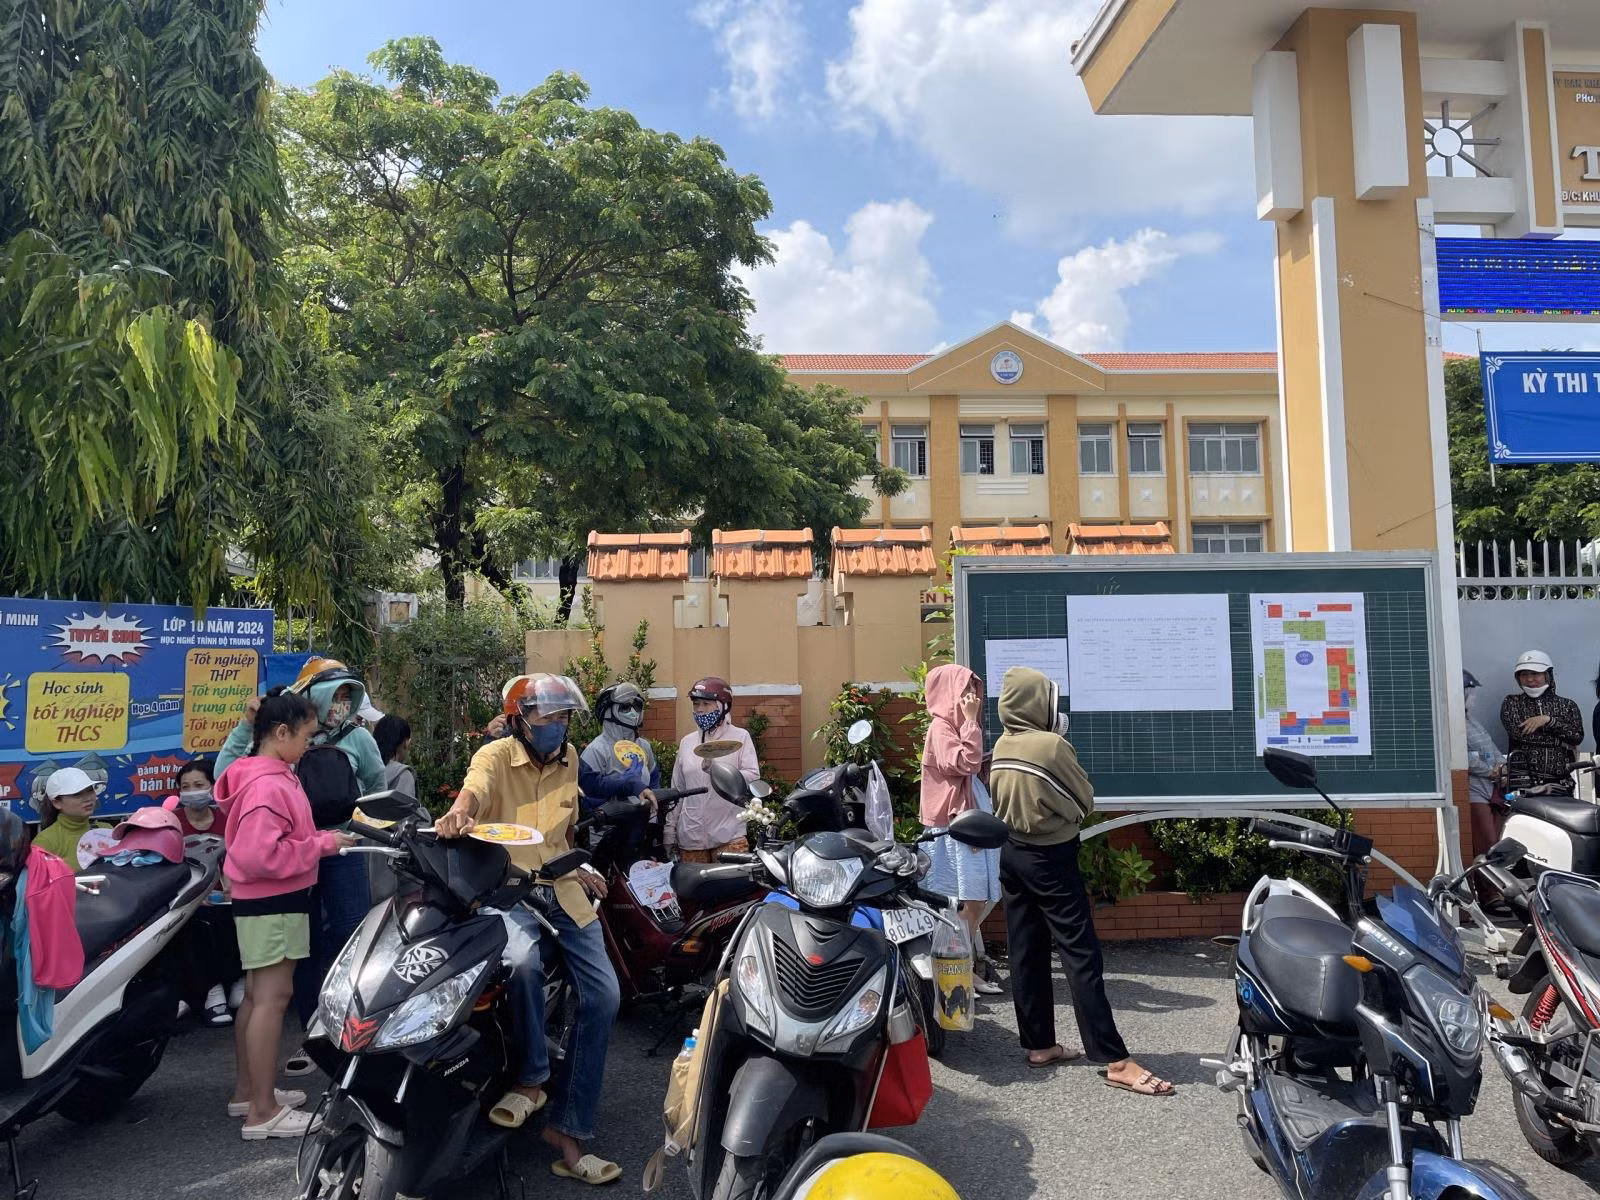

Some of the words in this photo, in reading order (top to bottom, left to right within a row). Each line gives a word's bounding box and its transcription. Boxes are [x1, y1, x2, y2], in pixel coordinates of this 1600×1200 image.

[1522, 367, 1548, 393] KỲ
[1553, 372, 1588, 393] THI
[6, 613, 39, 626] MINH
[163, 617, 186, 632] LỚP
[207, 619, 234, 634] NĂM
[237, 621, 264, 634] 2024
[112, 630, 142, 643] SINH
[160, 636, 175, 645] HỌC
[229, 637, 251, 646] TRUNG
[214, 654, 255, 667] nghiệp
[210, 669, 240, 681] THPT
[43, 681, 70, 697] Học
[73, 681, 104, 694] sinh
[212, 684, 253, 698] nghiệp
[33, 702, 59, 720] tốt
[63, 703, 125, 722] nghiệp
[131, 703, 150, 716] Học
[150, 702, 158, 712] 4
[159, 700, 180, 711] năm
[191, 703, 226, 714] trung
[57, 725, 102, 744] THCS
[190, 735, 215, 748] Cao
[161, 764, 171, 774] ký
[140, 777, 163, 792] bán
[888, 915, 934, 942] 804.49
[444, 1057, 469, 1077] HONDA
